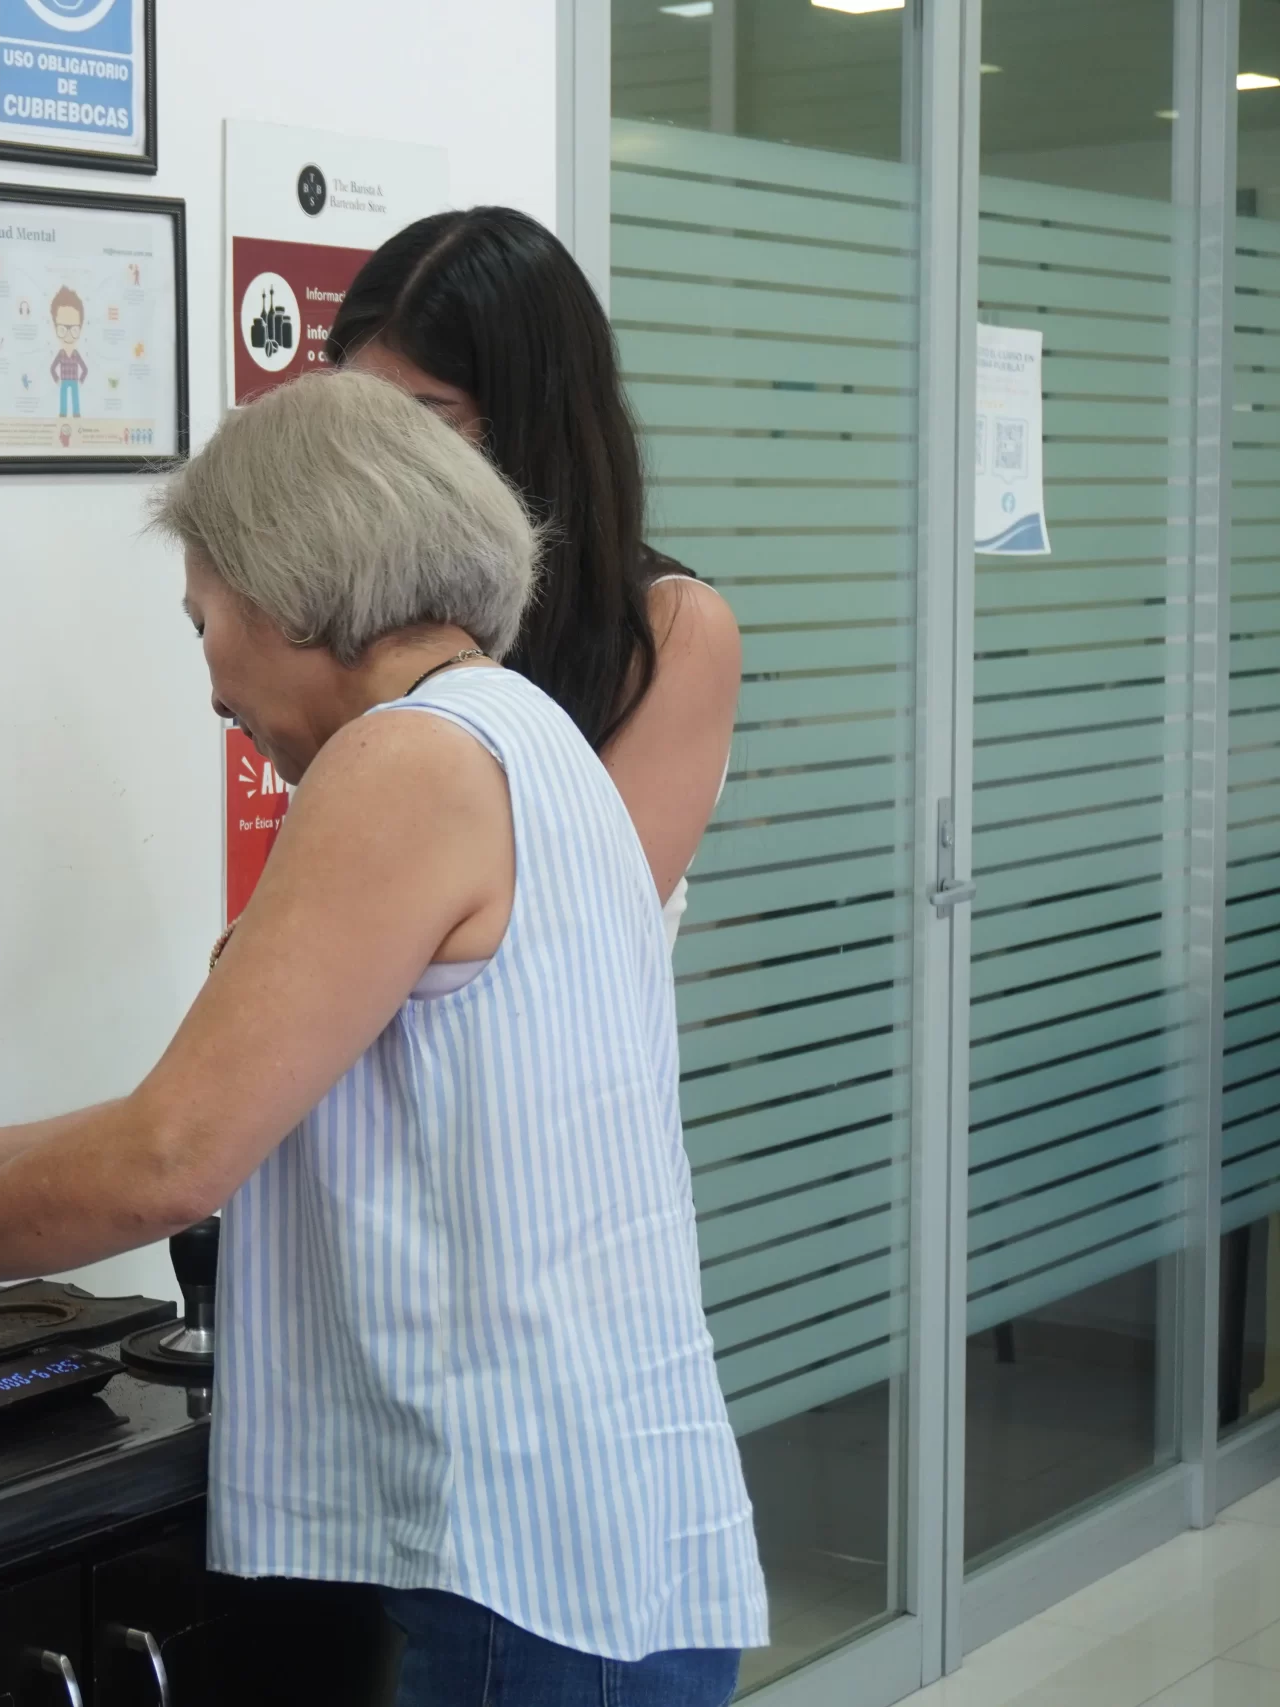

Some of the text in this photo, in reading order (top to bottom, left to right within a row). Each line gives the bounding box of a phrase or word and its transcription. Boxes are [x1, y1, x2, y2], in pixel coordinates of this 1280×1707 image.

[3, 49, 129, 81] USO OBLIGATORIO
[57, 78, 77, 95] DE
[3, 94, 129, 129] CUBREBOCAS
[332, 178, 383, 196] The Barista &
[330, 195, 387, 213] Bartender Store
[16, 227, 56, 242] Mental
[239, 819, 253, 831] Por
[255, 815, 273, 829] Ética
[275, 818, 280, 830] y
